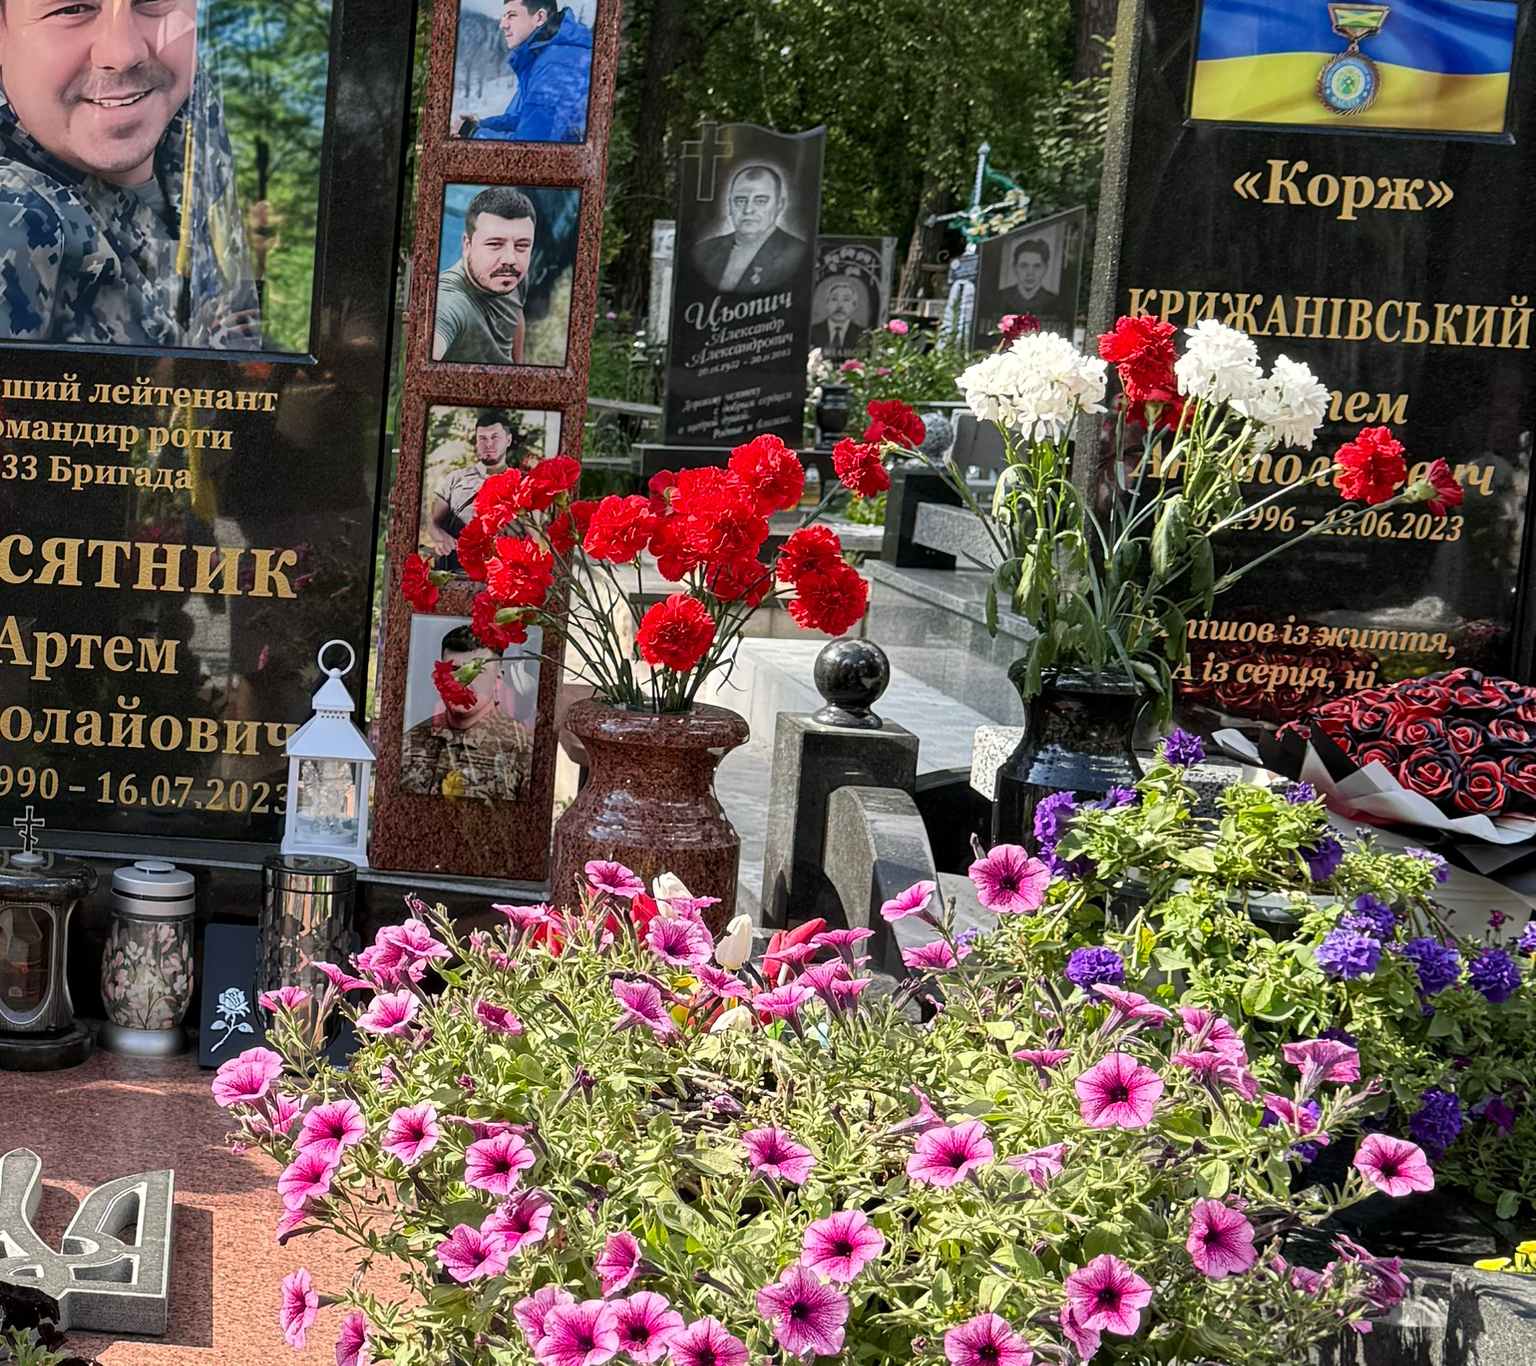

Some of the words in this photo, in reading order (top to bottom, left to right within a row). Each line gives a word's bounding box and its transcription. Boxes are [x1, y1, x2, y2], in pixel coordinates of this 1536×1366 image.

[1233, 159, 1454, 221] «Корж»
[685, 291, 793, 333] Цьопич
[1128, 288, 1535, 349] КРИЖАНІВСЬКИЙ
[89, 377, 279, 413] лейтенант
[148, 426, 233, 453] роти
[1, 454, 38, 480] 33
[48, 455, 194, 492] Бригада
[1281, 615, 1309, 645] із
[1314, 624, 1457, 661] життя,
[1202, 651, 1229, 683] із
[1236, 661, 1336, 695] серця,
[96, 770, 288, 816] 16.07.2023
